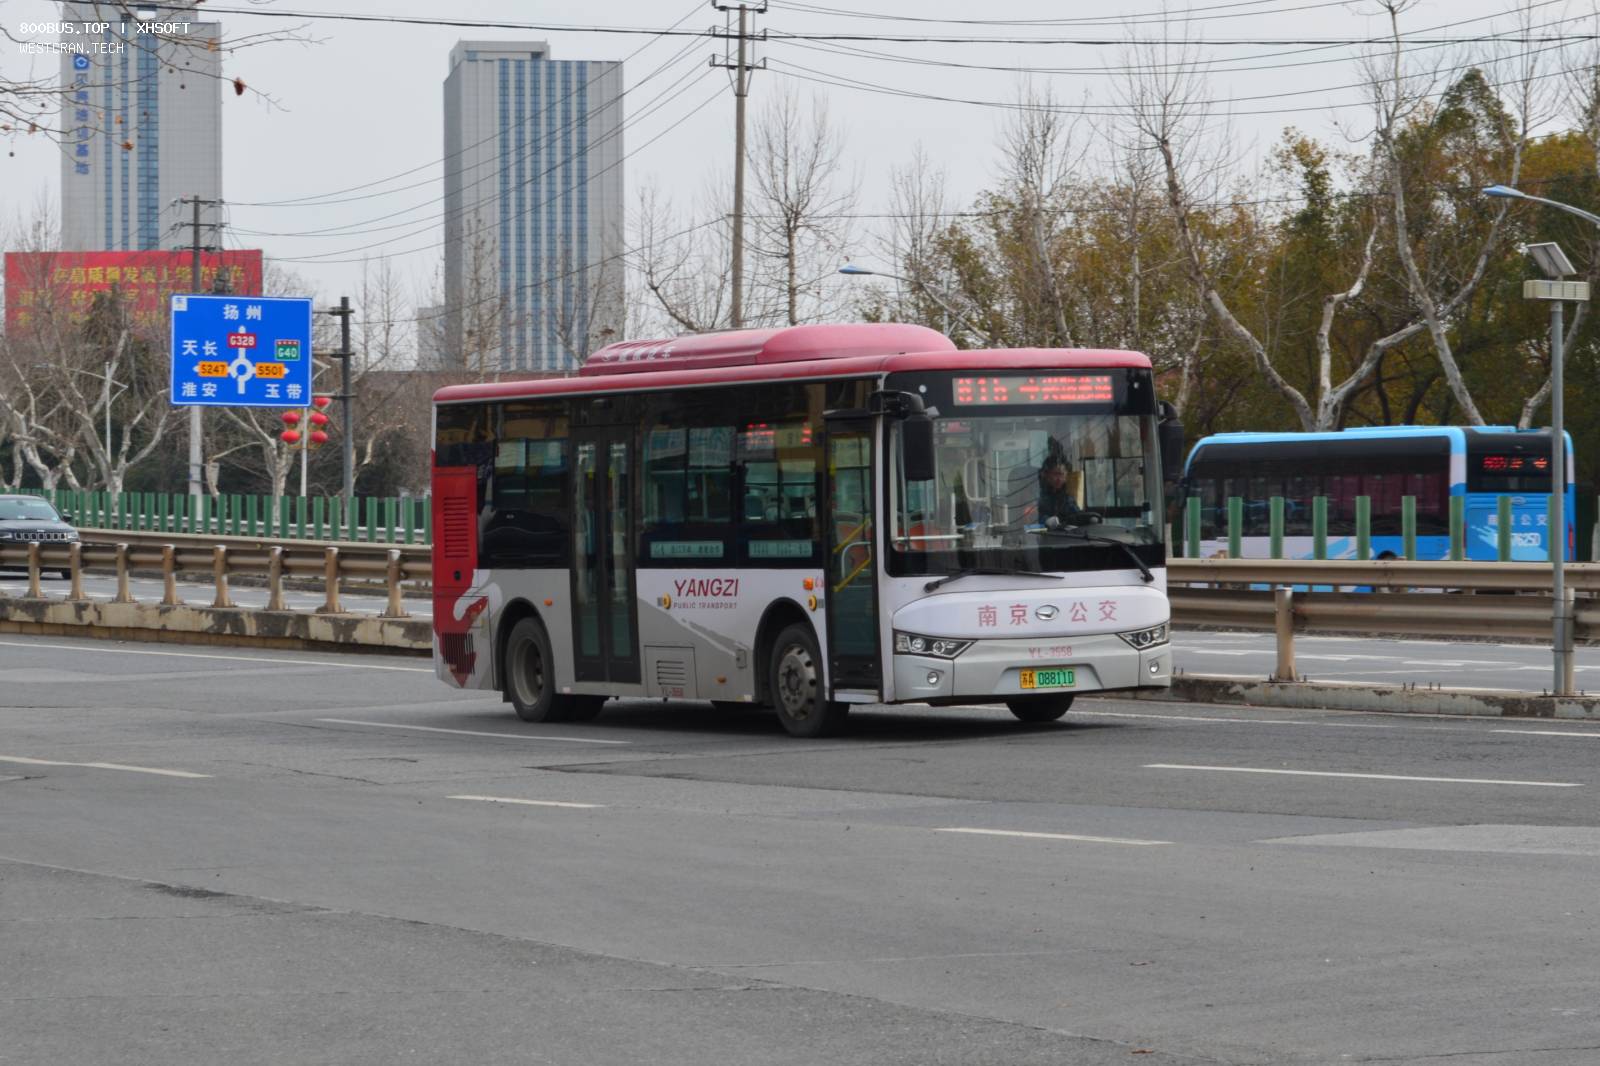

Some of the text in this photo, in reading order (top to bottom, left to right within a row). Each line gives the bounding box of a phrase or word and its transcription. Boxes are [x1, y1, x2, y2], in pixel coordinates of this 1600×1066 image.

[223, 303, 262, 321] 扬州
[181, 339, 218, 356] 天长
[229, 335, 255, 347] G328
[277, 347, 297, 358] G40
[201, 364, 226, 374] S247
[257, 365, 282, 376] S501
[181, 382, 218, 397] 淮安
[264, 383, 303, 400] 玉带
[673, 578, 739, 597] YANGZI
[672, 602, 737, 610] PUBLIC TRANSPORT
[977, 600, 1119, 628] 南京 公交
